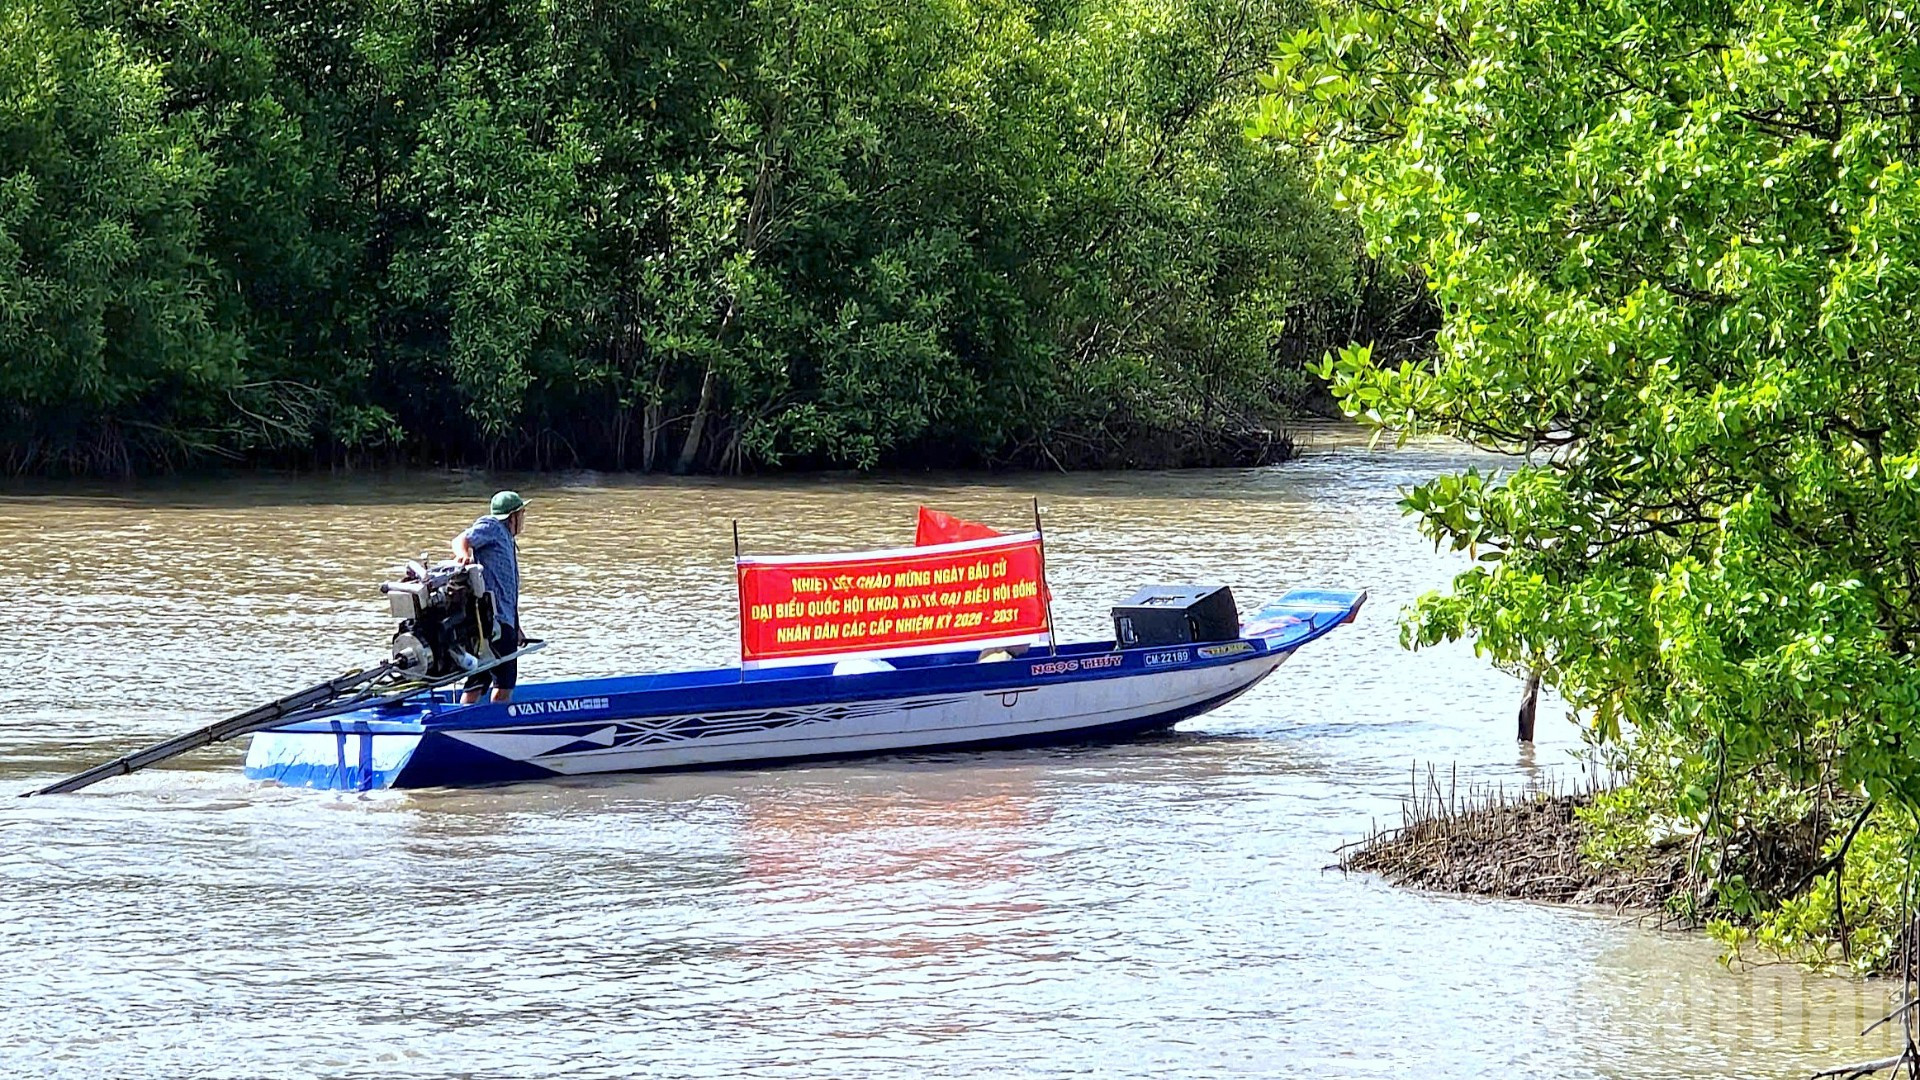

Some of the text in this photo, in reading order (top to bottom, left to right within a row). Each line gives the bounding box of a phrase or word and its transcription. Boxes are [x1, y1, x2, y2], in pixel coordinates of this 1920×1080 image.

[856, 572, 891, 589] CHÀO
[895, 569, 930, 588] MỪNG
[934, 564, 964, 584] NGÀY
[968, 559, 990, 580] BẦU
[993, 557, 1008, 577] CỬ
[776, 596, 804, 618] BIỂU
[808, 595, 840, 618] QUỐC
[843, 595, 864, 616] HỘI
[963, 583, 990, 605] BIỂU
[992, 583, 1010, 604] HỘI
[777, 624, 811, 643] NHÂN
[813, 621, 840, 640] DÂN
[841, 619, 867, 638] CÁC
[869, 614, 893, 636] CẤP
[895, 614, 934, 634] NHIỆM
[953, 612, 983, 628] 2026
[991, 608, 1019, 624] 2031
[1031, 660, 1078, 675] NGỌC
[547, 699, 579, 713] NAM
